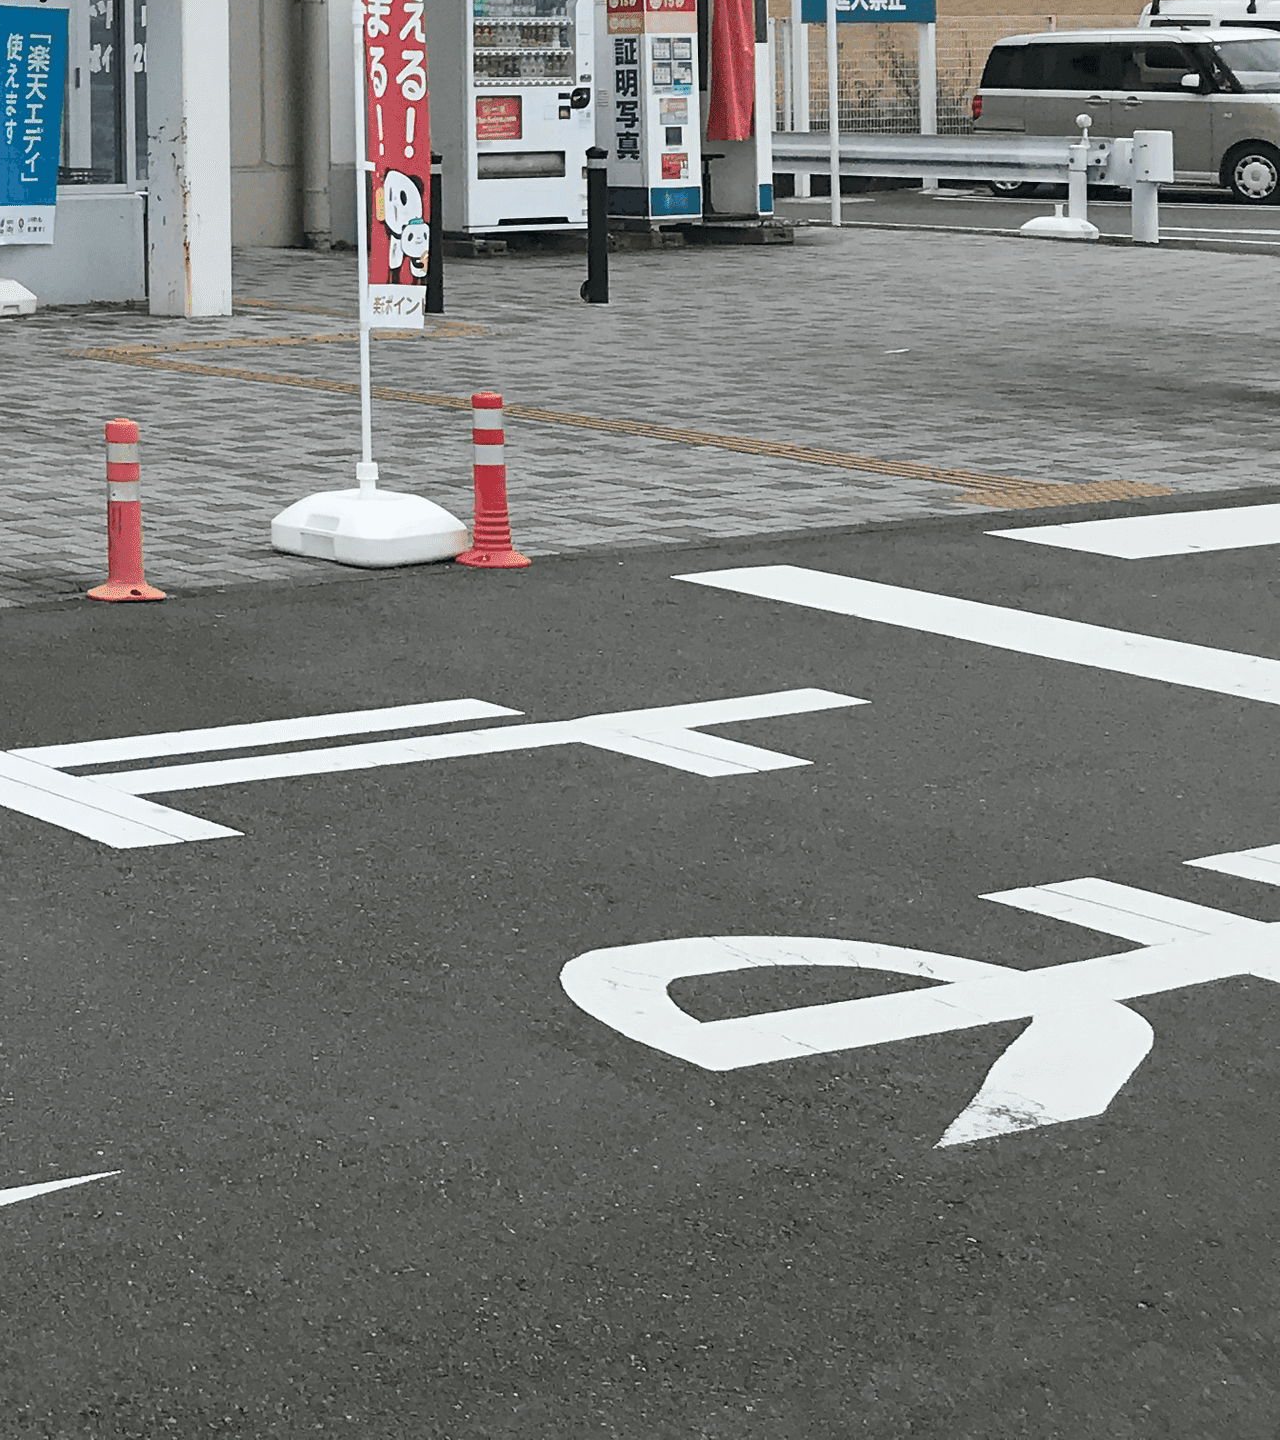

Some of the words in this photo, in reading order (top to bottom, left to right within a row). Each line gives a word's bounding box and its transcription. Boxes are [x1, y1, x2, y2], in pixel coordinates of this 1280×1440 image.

[4, 32, 24, 145] 使えます
[21, 33, 52, 182] 「楽天エディ」
[614, 37, 640, 161] 証明写真
